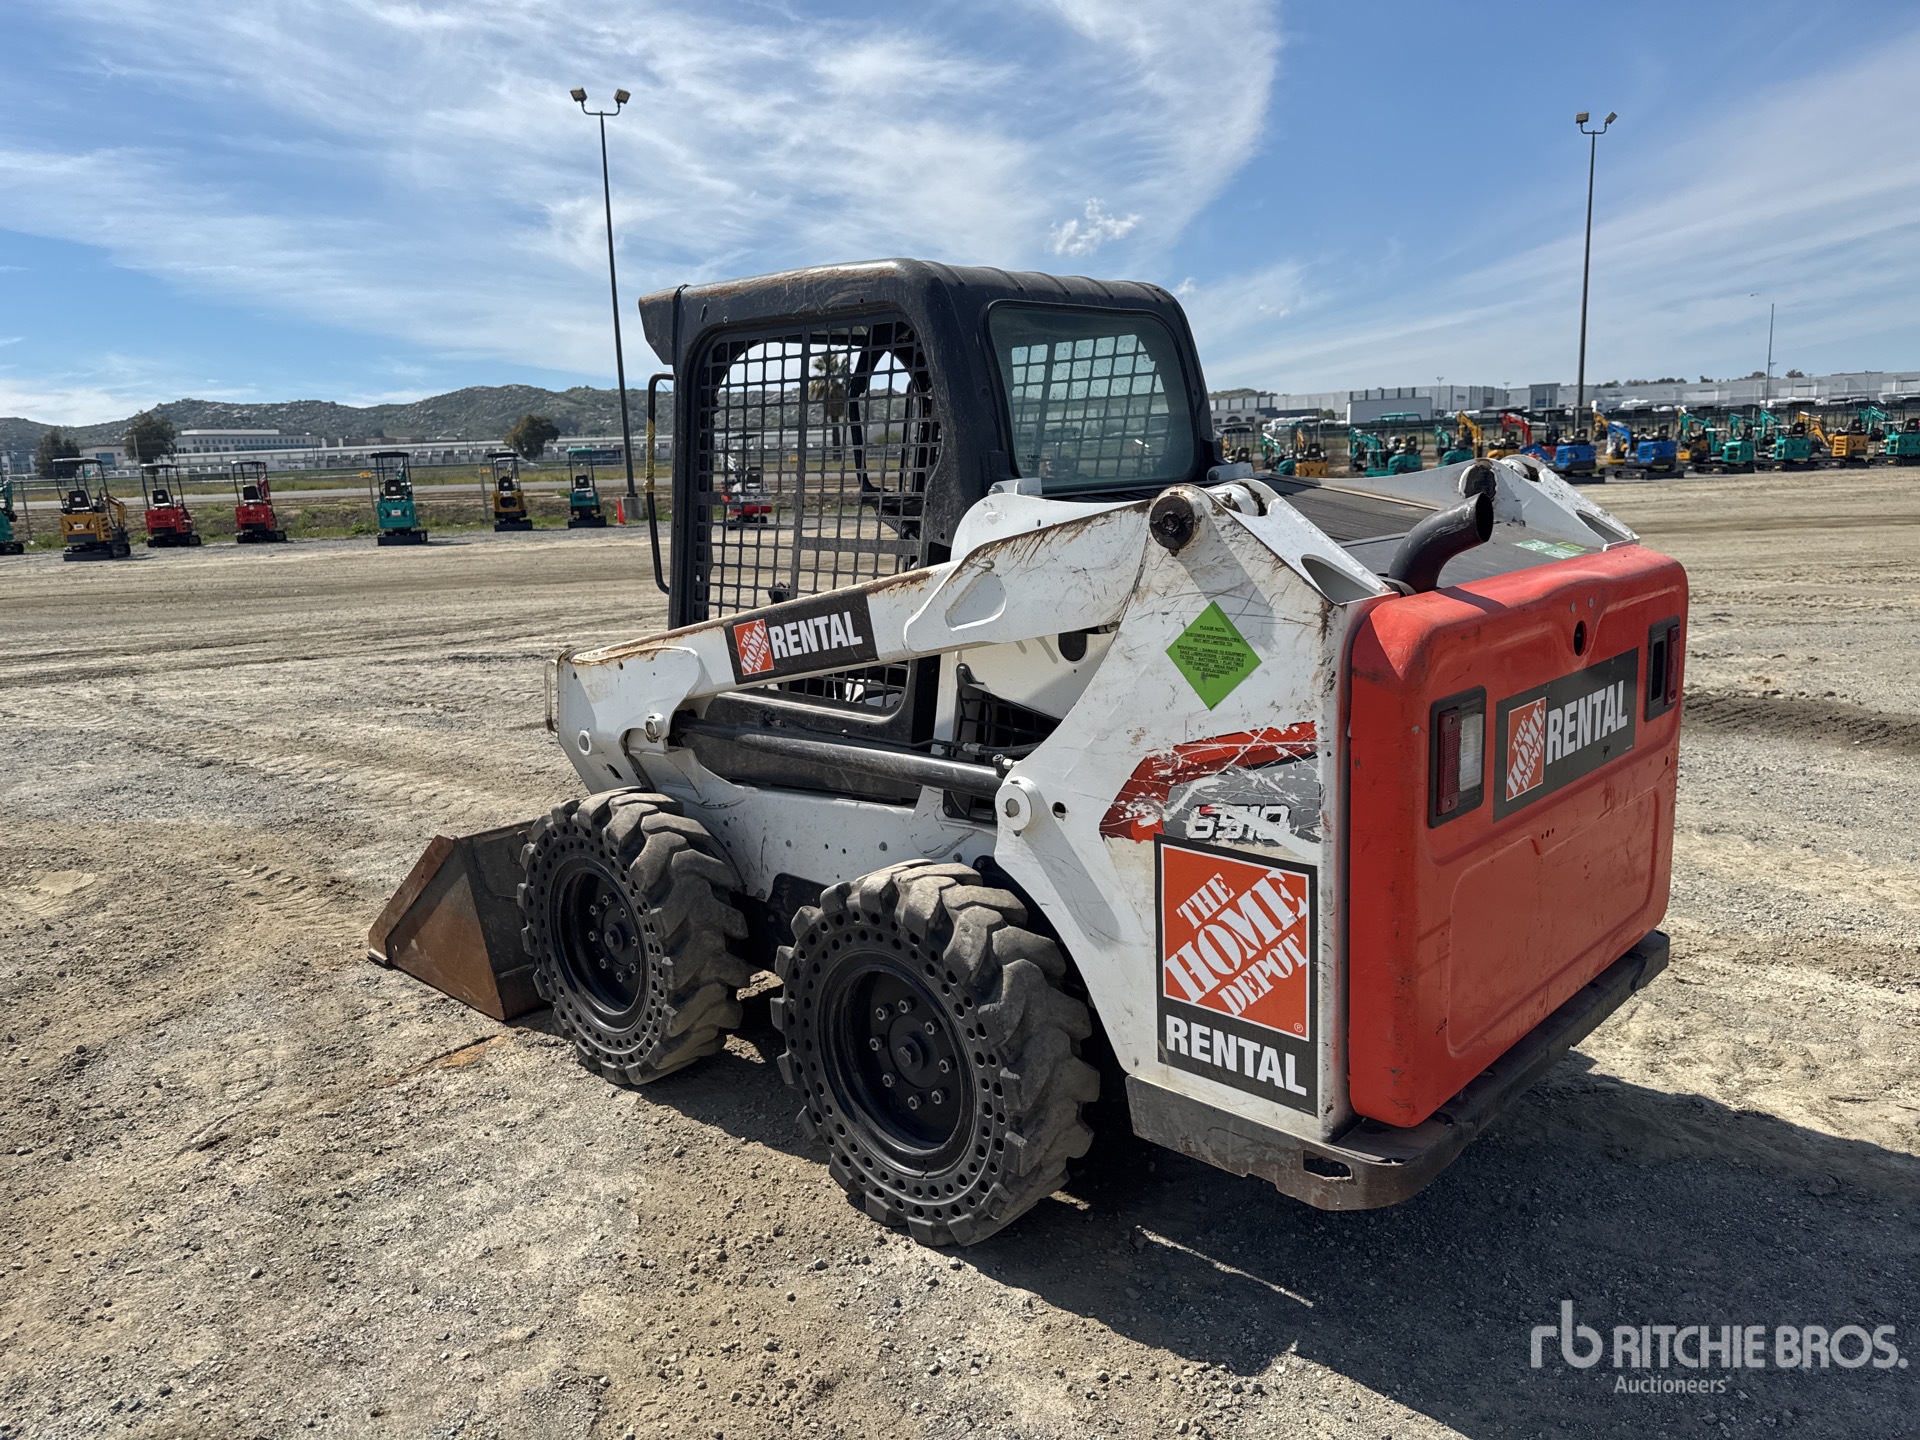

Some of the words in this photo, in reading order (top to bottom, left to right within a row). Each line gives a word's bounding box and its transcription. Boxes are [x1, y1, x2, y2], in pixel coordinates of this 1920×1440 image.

[742, 621, 766, 674] HOME
[768, 611, 863, 660] RENTAL
[1507, 700, 1545, 796] HOME
[1512, 714, 1528, 752] THE
[1547, 680, 1628, 765] RENTAL
[1165, 869, 1309, 1004] HOME
[1176, 872, 1235, 929] THE
[1218, 933, 1308, 1017] DEPOT
[1166, 1014, 1307, 1096] RENTAL
